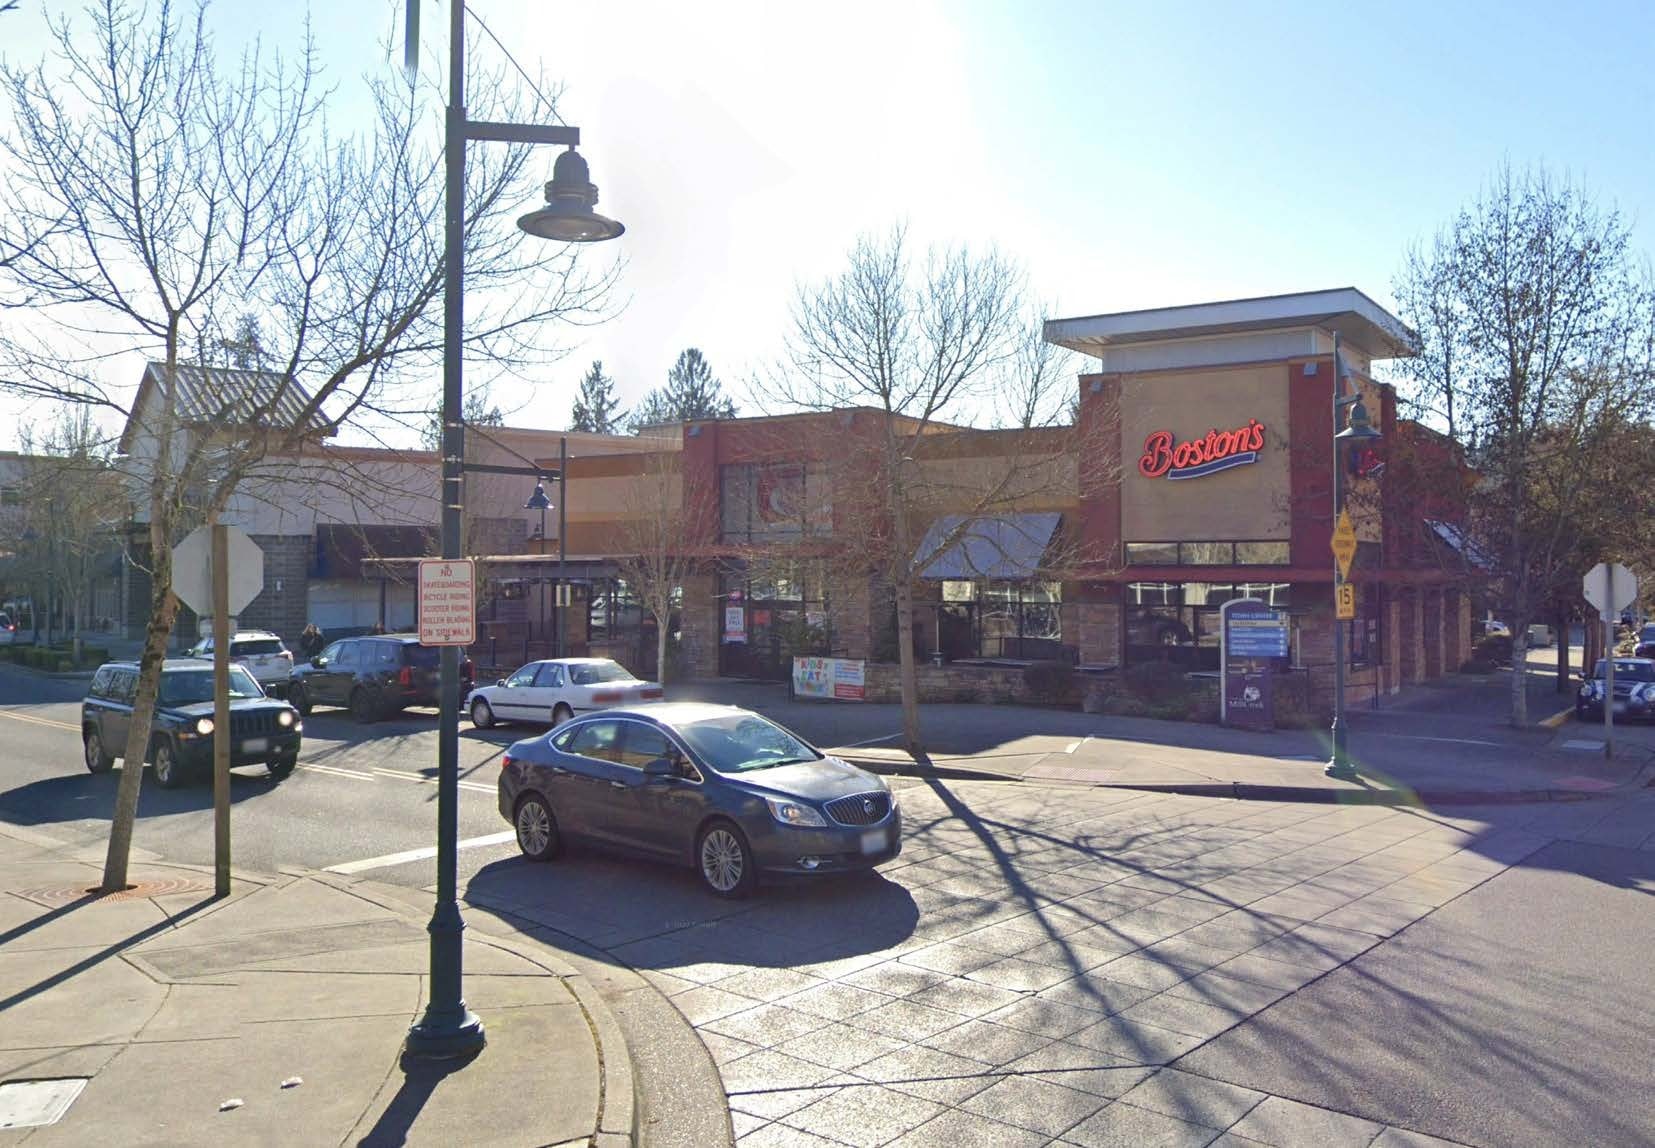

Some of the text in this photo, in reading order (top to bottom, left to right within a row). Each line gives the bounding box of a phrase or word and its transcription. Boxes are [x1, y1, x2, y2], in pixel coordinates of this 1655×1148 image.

[1138, 418, 1265, 478] Boston's
[440, 569, 453, 577] NO
[424, 581, 471, 589] SKATEBOARDING
[424, 593, 448, 601] BICYCLE
[1338, 588, 1351, 605] 15
[424, 628, 433, 637] ON
